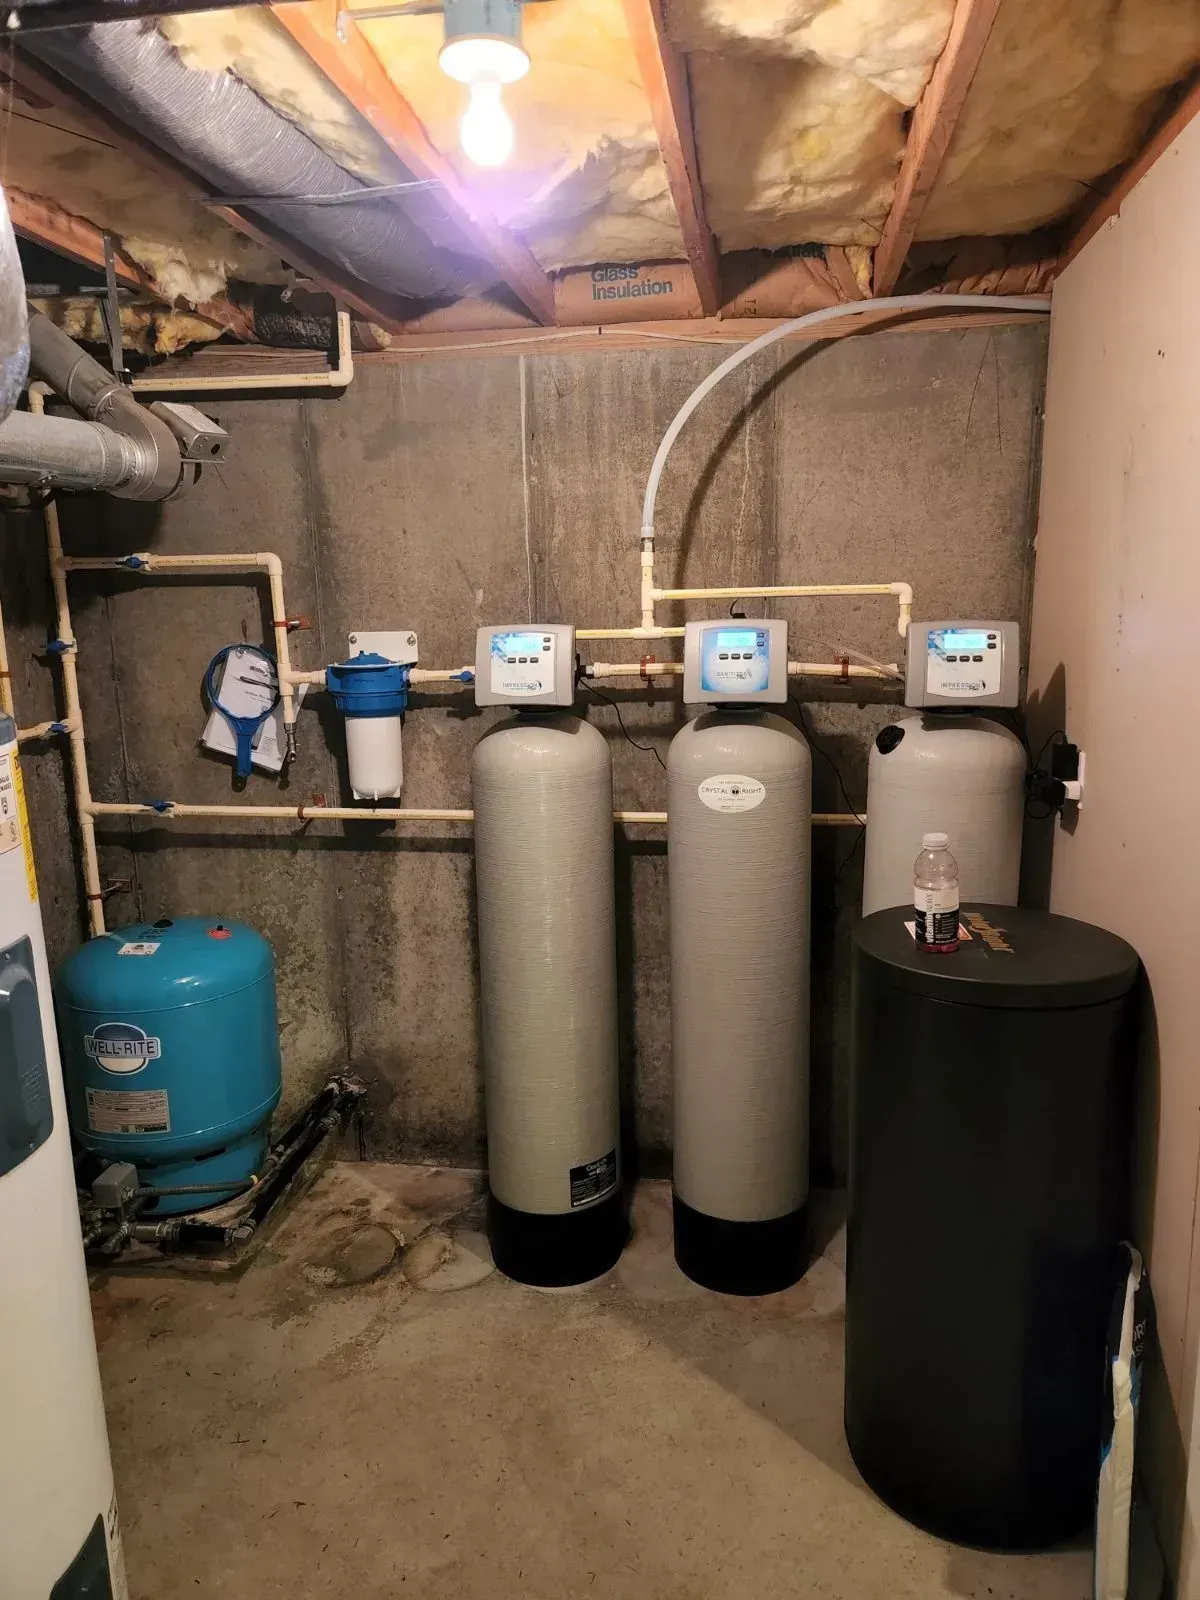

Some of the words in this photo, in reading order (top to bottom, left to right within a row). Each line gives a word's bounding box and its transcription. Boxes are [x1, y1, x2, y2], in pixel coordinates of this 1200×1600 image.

[591, 267, 638, 282] Glass
[592, 279, 673, 300] Insulation
[88, 1039, 155, 1055] WELL-RITE
